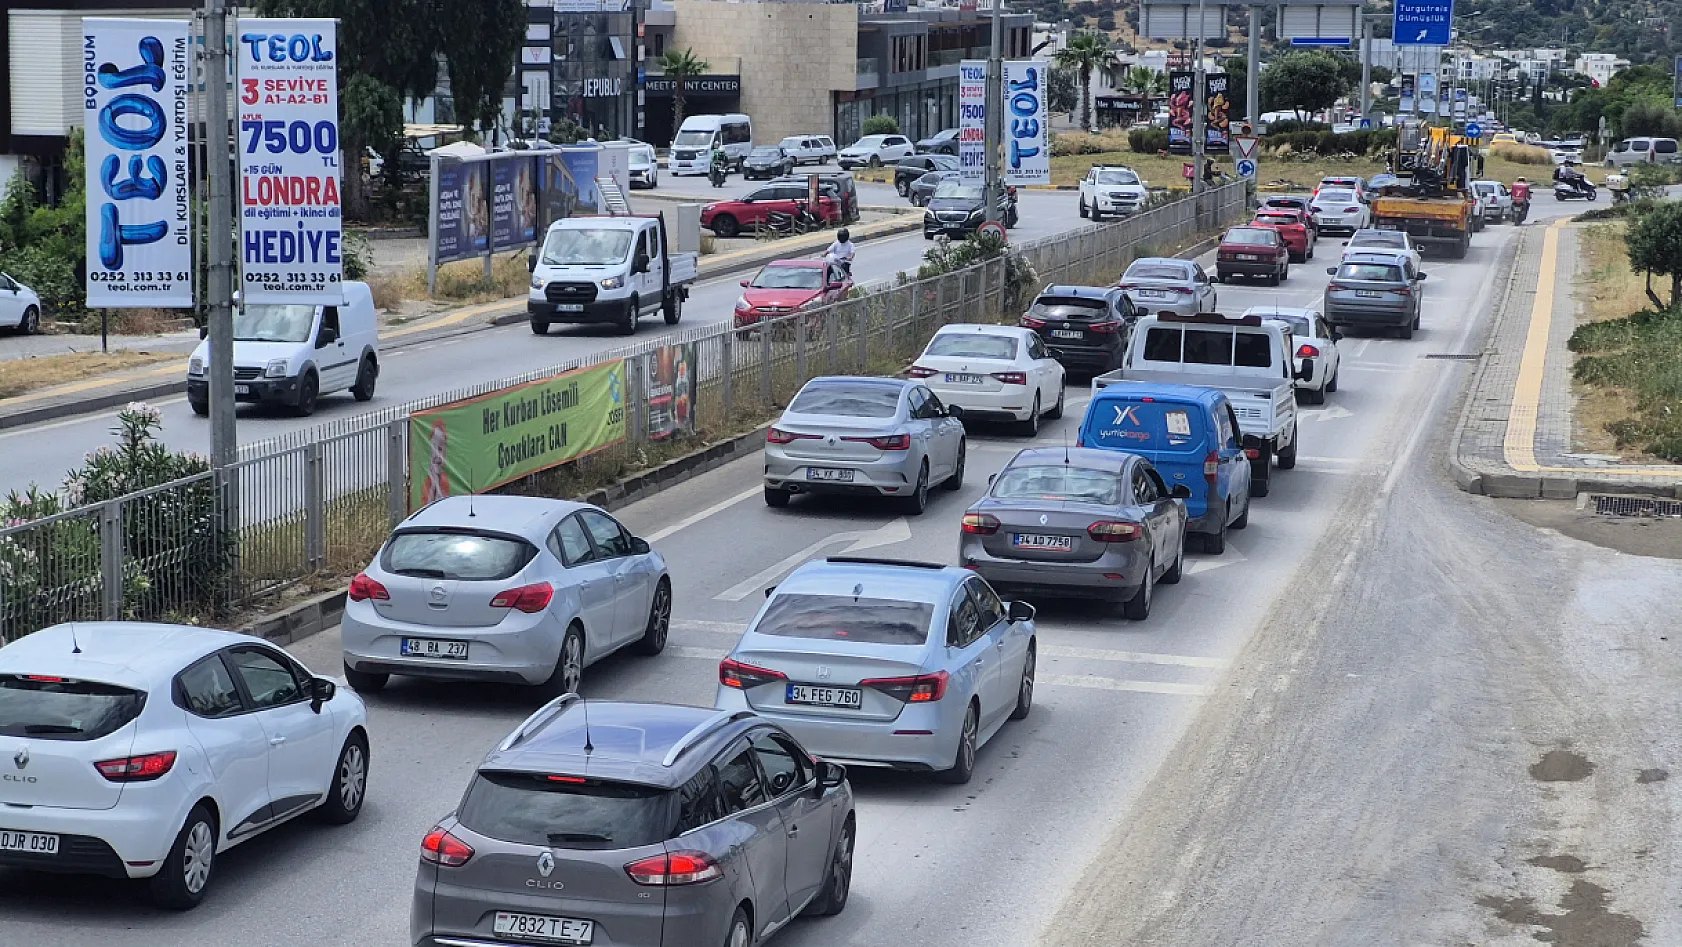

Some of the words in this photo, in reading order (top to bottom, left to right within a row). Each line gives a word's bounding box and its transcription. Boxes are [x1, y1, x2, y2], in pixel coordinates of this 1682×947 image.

[241, 33, 334, 62] TEOL
[171, 38, 186, 81] EĞİTİM
[84, 36, 98, 109] BODRUM
[961, 68, 985, 79] TEOL
[241, 78, 259, 105] 3
[264, 75, 328, 92] SEVİYE
[646, 81, 669, 90] MEET
[672, 81, 699, 90] PINT
[701, 81, 738, 91] CENTER
[264, 94, 328, 104] A1-A2-B1
[174, 85, 187, 141] YURTDIŞI
[961, 105, 984, 119] 7500
[1009, 68, 1039, 169] TEOL
[242, 120, 337, 154] 7500
[98, 36, 168, 270] TEOL
[174, 146, 186, 156] &
[243, 165, 259, 175] +15
[260, 163, 283, 175] GÜN
[321, 156, 338, 168] TL
[175, 160, 187, 221] KURSLARI
[243, 176, 339, 206] LONDRA
[244, 207, 256, 217] dil
[258, 207, 291, 220] eğitimi
[300, 207, 327, 217] ikinci
[328, 207, 341, 217] dil
[174, 225, 188, 245] DİL
[245, 220, 341, 263] HEDİYE
[90, 271, 125, 281] 0252
[133, 271, 153, 281] 313
[157, 271, 172, 281] 33
[176, 271, 189, 281] 61
[246, 273, 279, 282] 0252
[287, 273, 306, 282] 313
[310, 273, 325, 282] 33
[329, 273, 341, 282] 61
[107, 283, 172, 291] teol.com.tr
[264, 283, 325, 291] teol.com.tr
[483, 407, 500, 435] Her
[504, 397, 538, 428] Kurban
[541, 381, 579, 416] Lösemili
[498, 433, 545, 477] Çocuklara
[549, 422, 567, 450] CAN
[408, 640, 420, 651] 48
[428, 641, 439, 653] BA
[448, 642, 465, 654] 237
[793, 687, 806, 700] 34
[811, 689, 832, 702] FEG
[837, 690, 858, 704] 760
[3, 774, 37, 783] CLIO
[1, 832, 26, 849] DJR
[31, 835, 55, 850] 030
[526, 879, 564, 890] CLIO
[509, 914, 545, 934] 7832
[549, 918, 590, 938] TE-7
